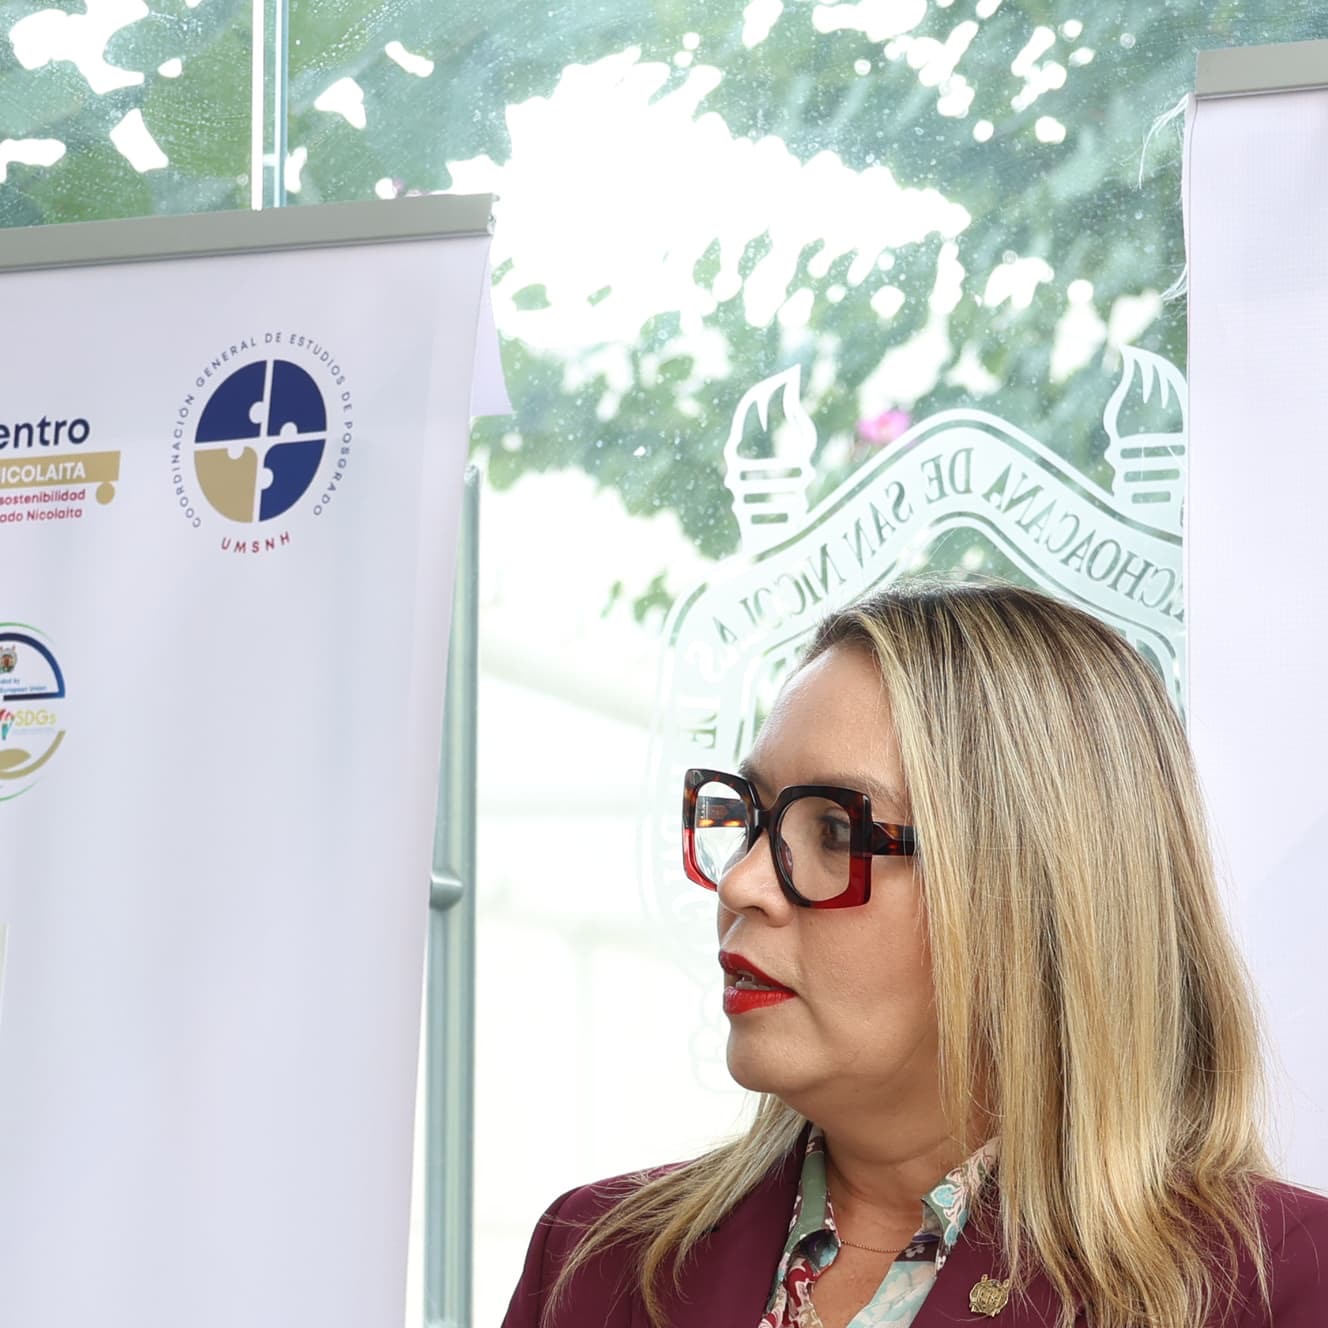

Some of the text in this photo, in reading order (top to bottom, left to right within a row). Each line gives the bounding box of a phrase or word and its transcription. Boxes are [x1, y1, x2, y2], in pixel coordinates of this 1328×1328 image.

[172, 332, 353, 528] COORDINACIÓN GENERAL DE ESTUDIOS DE POSGRADO
[0, 489, 86, 505] sostenibilidad
[27, 507, 82, 521] Nicolaita
[221, 531, 291, 554] UMSNH
